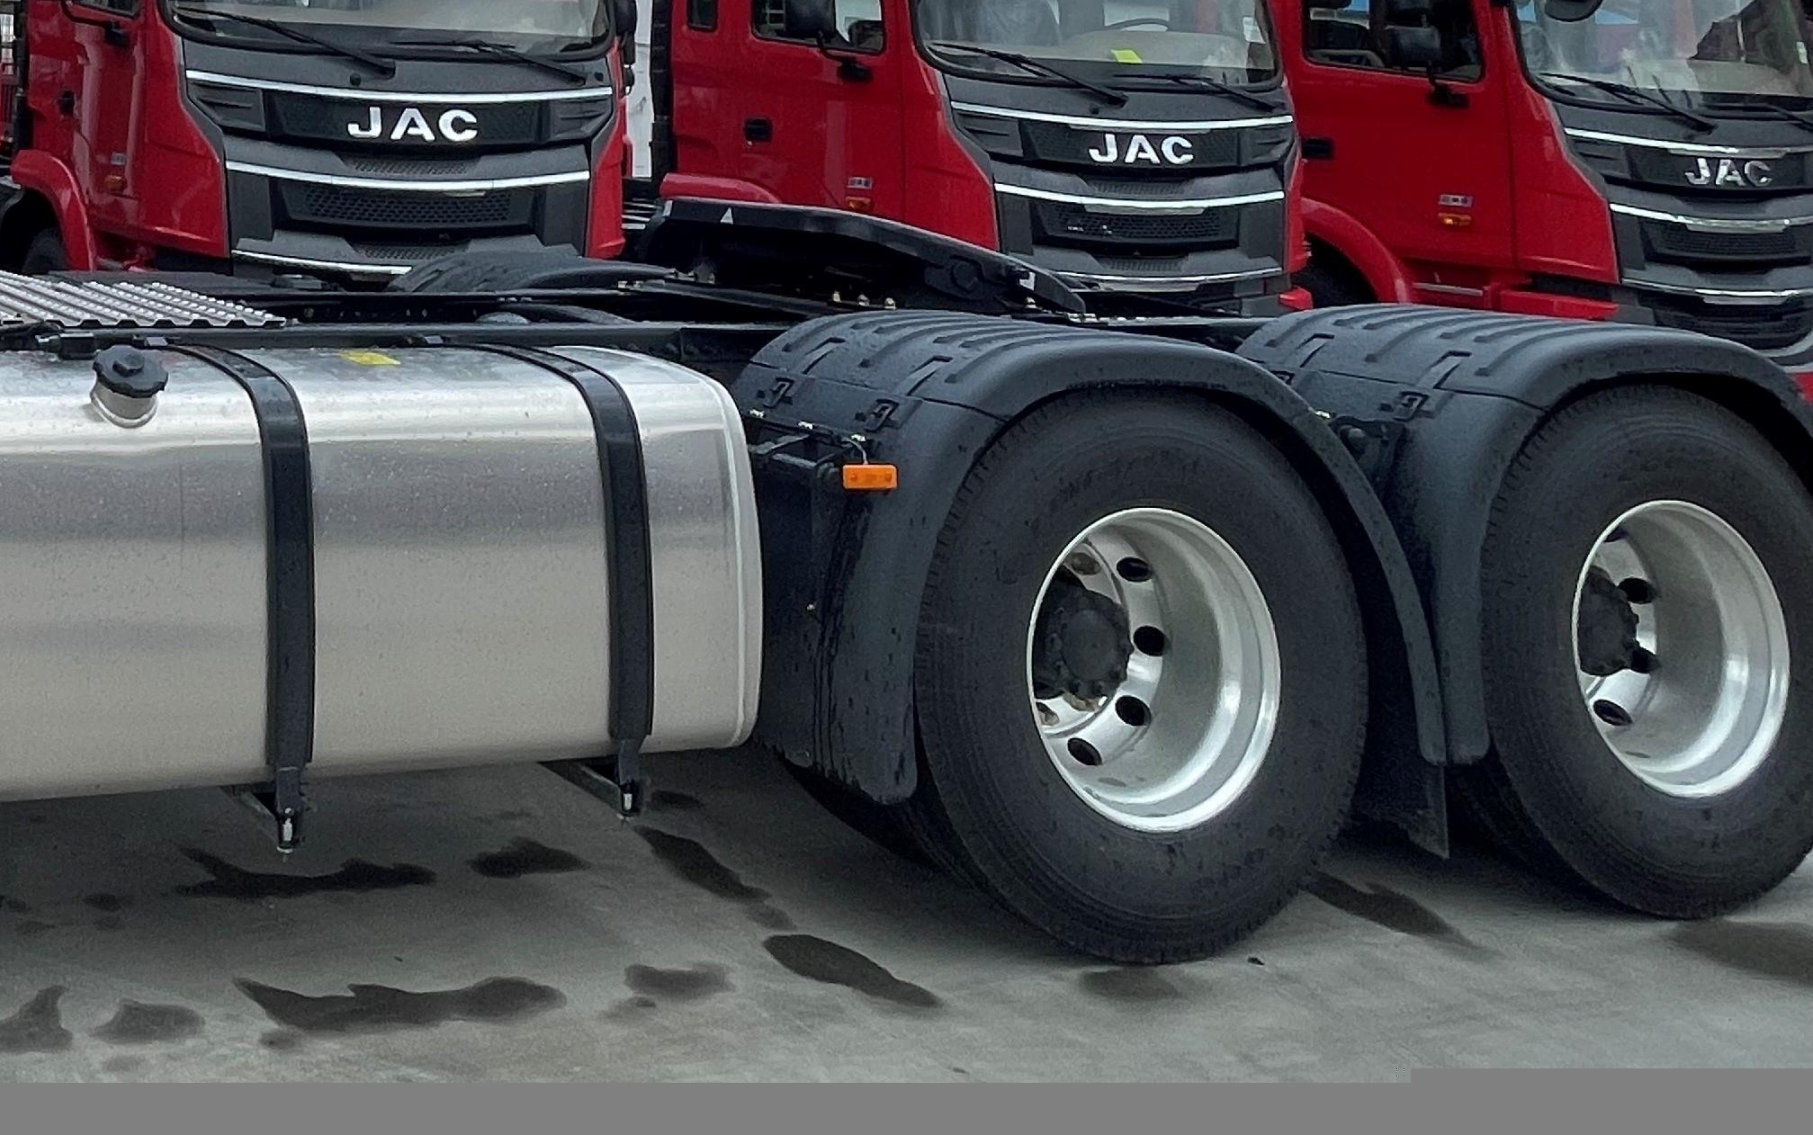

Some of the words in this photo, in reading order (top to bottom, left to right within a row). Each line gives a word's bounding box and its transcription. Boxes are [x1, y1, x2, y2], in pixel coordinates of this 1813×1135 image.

[347, 106, 478, 142] JAC
[1088, 133, 1194, 165] JAC
[1684, 157, 1773, 187] JAC
